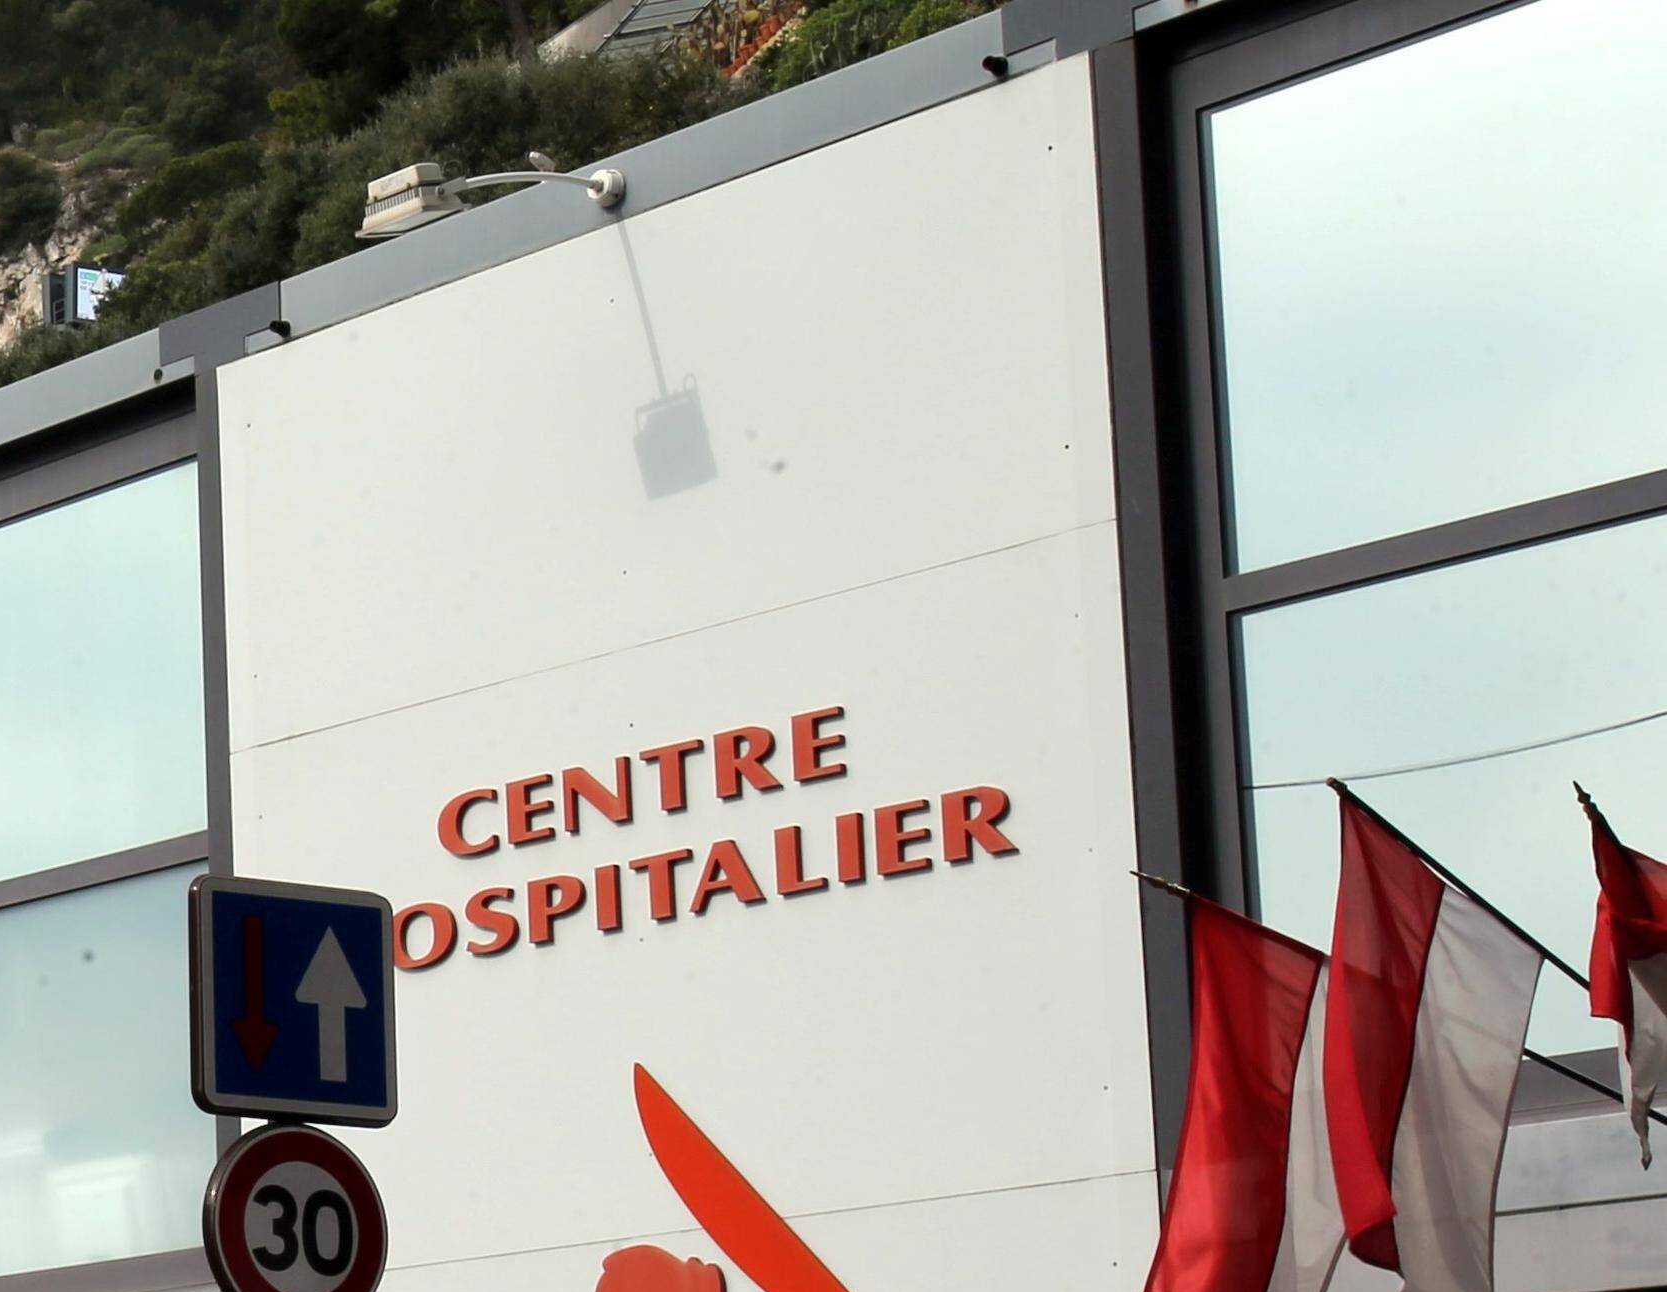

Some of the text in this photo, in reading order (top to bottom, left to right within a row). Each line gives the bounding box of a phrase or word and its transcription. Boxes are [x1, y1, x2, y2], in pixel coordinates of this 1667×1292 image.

[437, 705, 849, 858] CENTRE
[393, 784, 1019, 971] OSPITALIER
[252, 1184, 355, 1278] 30
